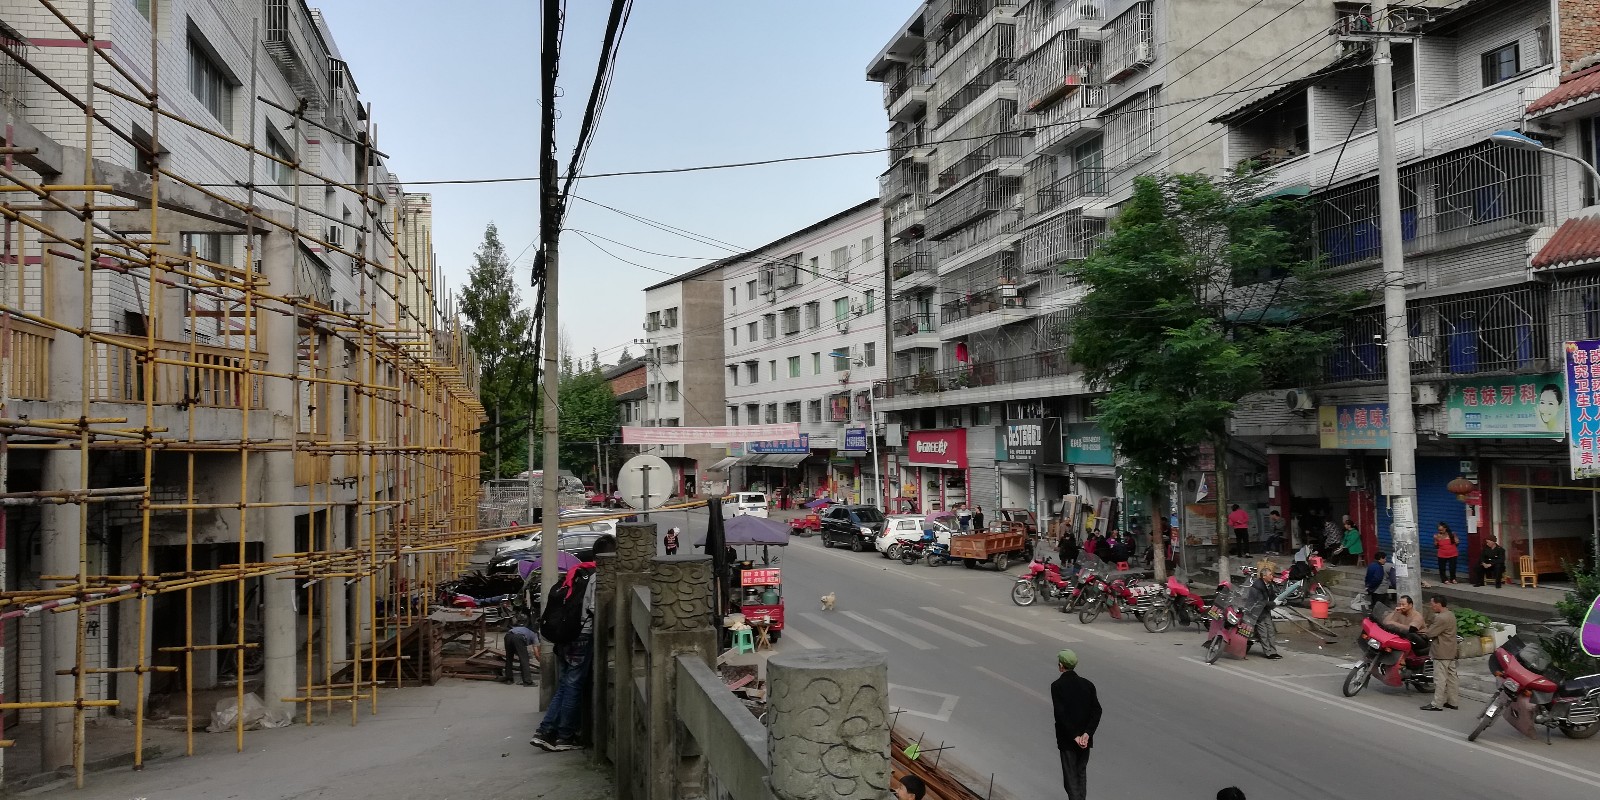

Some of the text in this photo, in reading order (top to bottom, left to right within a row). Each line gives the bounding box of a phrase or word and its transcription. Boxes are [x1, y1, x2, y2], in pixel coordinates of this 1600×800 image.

[1463, 384, 1538, 406] 范妹牙科
[1339, 407, 1391, 429] 小镇味
[1573, 350, 1593, 465] 讲究卫生人人有责
